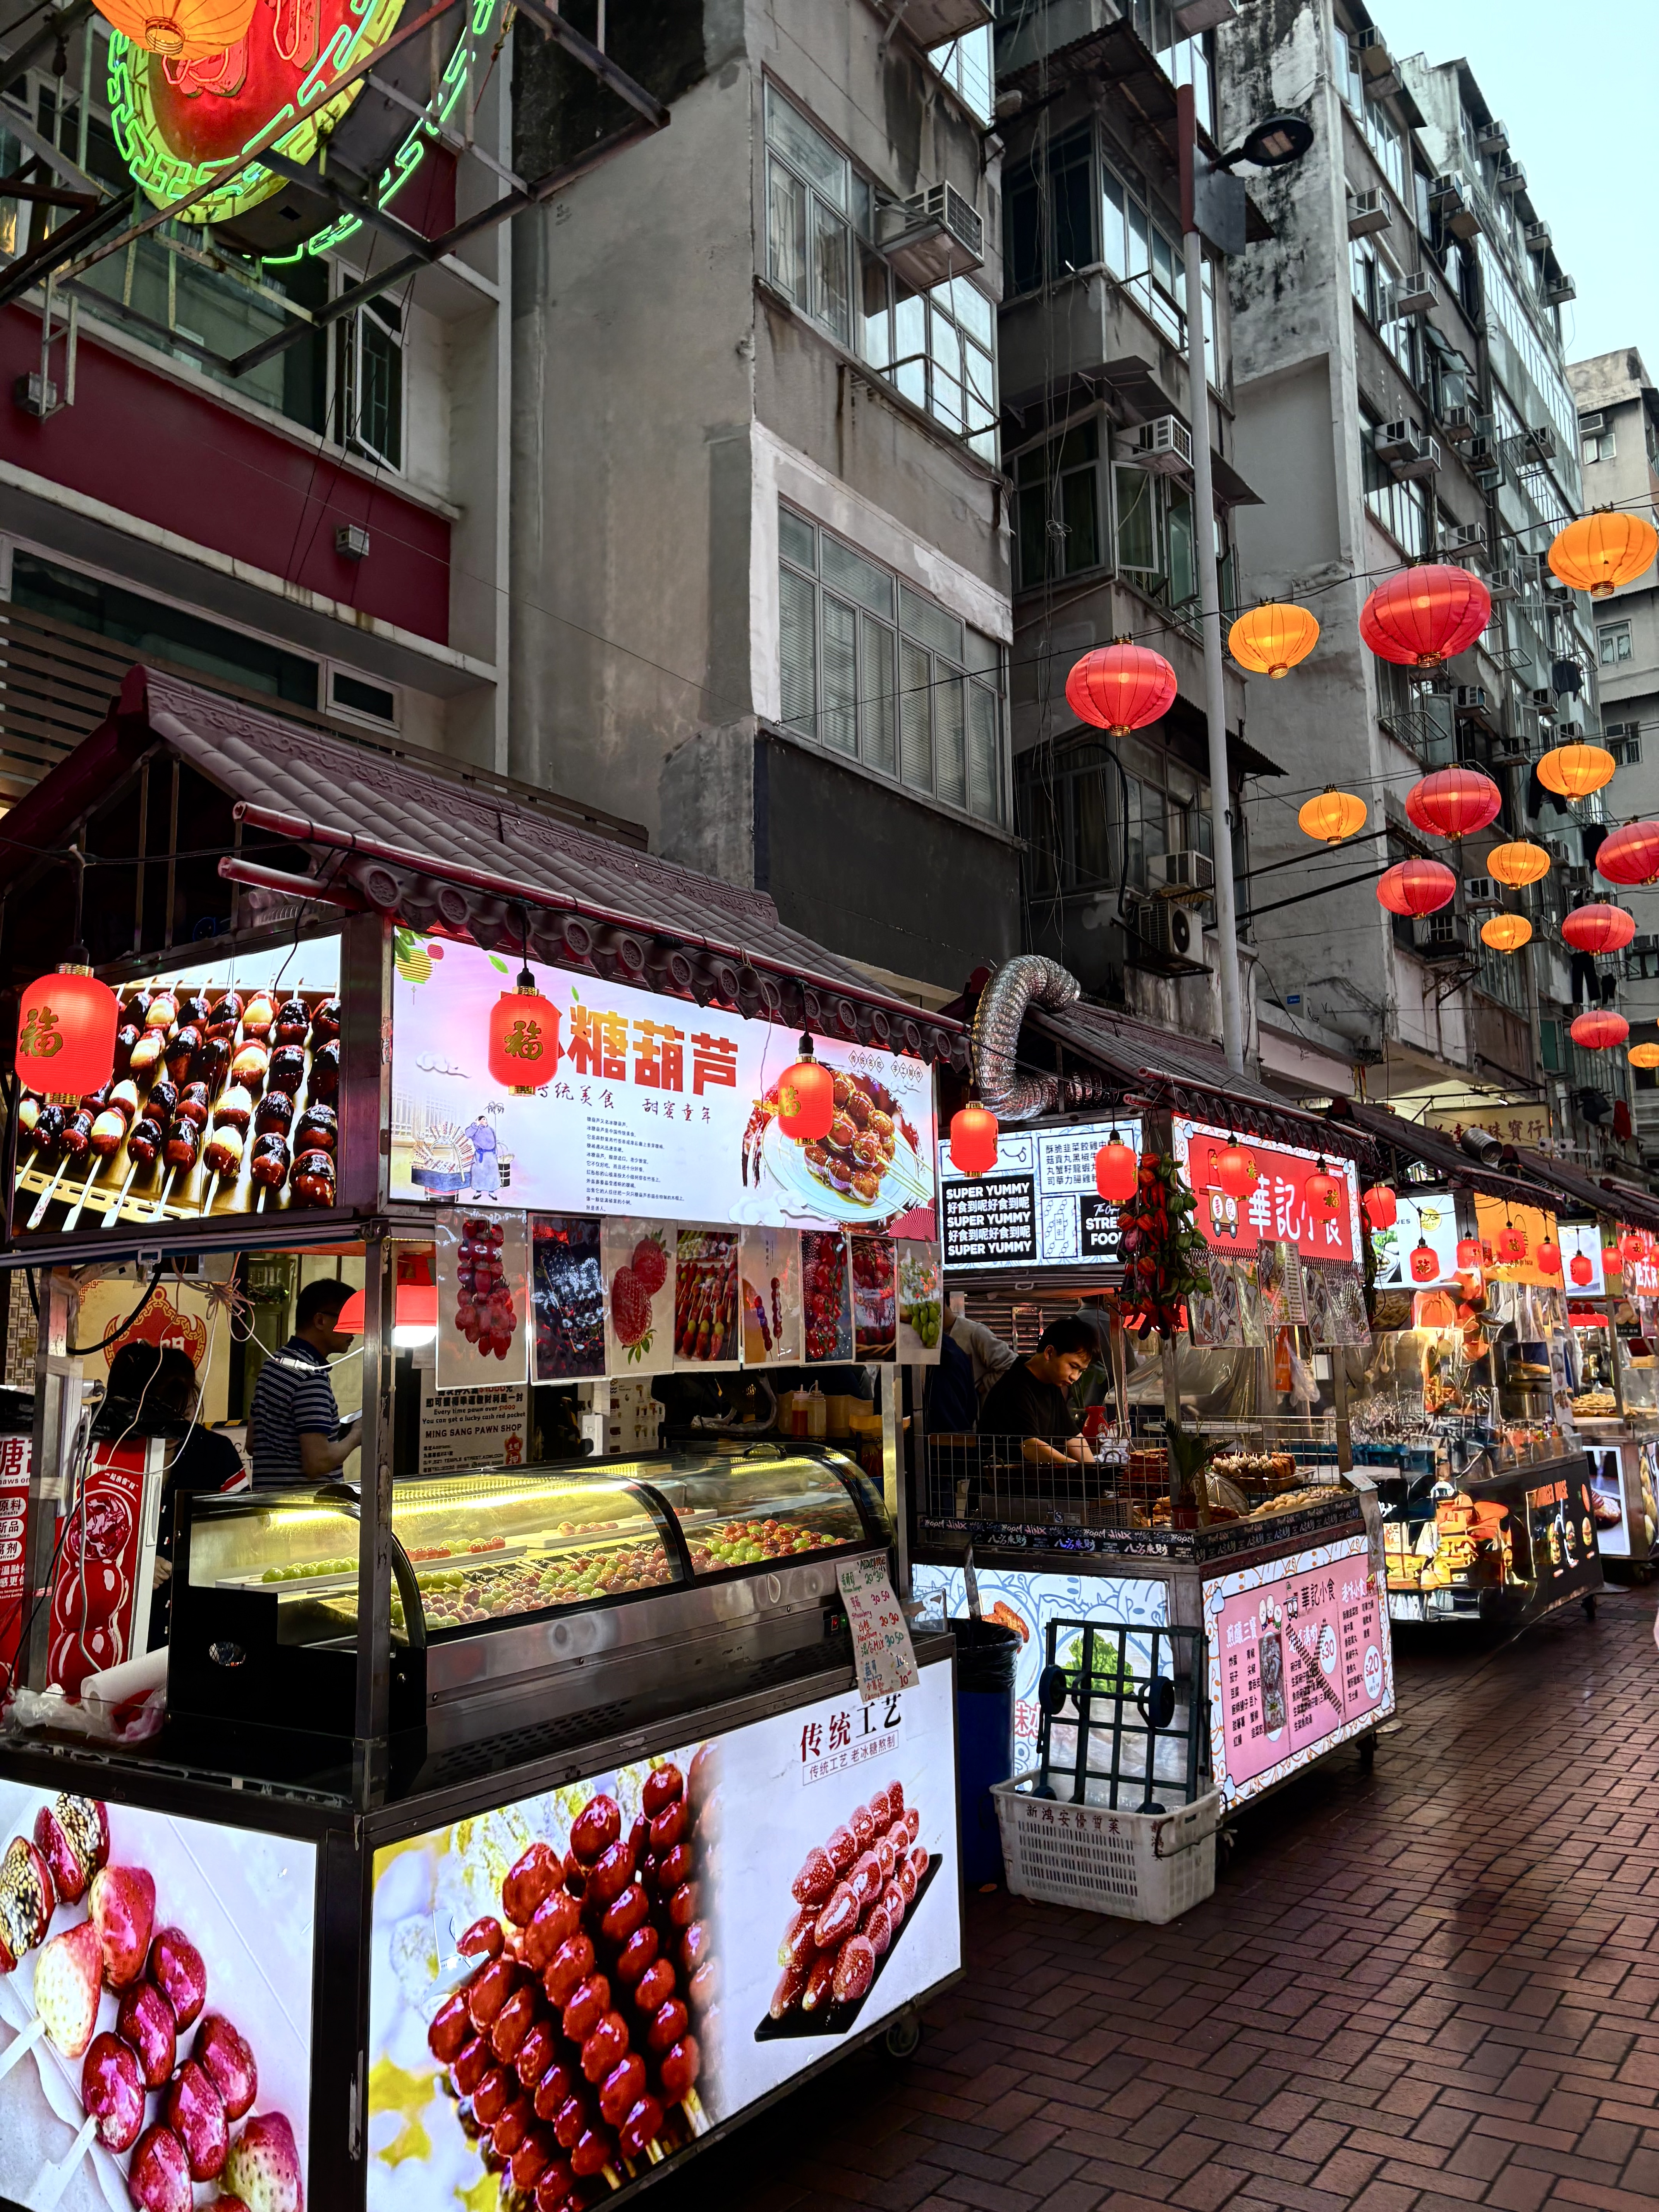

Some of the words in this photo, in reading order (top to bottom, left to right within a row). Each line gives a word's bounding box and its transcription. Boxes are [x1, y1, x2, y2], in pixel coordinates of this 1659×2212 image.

[20, 1006, 63, 1057] 福
[504, 1020, 543, 1060] 福
[558, 1005, 738, 1096] 糖葫芦
[642, 1098, 711, 1124] 甜蜜童年
[946, 1187, 983, 1199] SUPER
[986, 1182, 1030, 1196] YUMMY
[947, 1196, 1030, 1214] 好食到呢好食到呢
[947, 1215, 984, 1227] SUPER
[987, 1211, 1031, 1224] YUMMY
[1085, 1216, 1119, 1230] STRE
[948, 1225, 1030, 1242] 好食到呢好食到呢
[948, 1243, 986, 1256] SUPER
[988, 1240, 1032, 1254] YUMMY
[426, 1430, 447, 1438] MING
[450, 1427, 472, 1436] SANG
[475, 1425, 498, 1434] PAWN
[501, 1424, 522, 1432] SHOP
[875, 1570, 883, 1582] 30
[871, 1594, 880, 1605] 30
[881, 1590, 890, 1601] 50
[889, 1612, 899, 1625] 30
[895, 1632, 904, 1644] 50
[1366, 1653, 1379, 1677] $20
[899, 1675, 908, 1688] 10
[800, 1693, 901, 1762] 传统工艺
[810, 1753, 847, 1780] 传统工艺
[851, 1734, 895, 1762] 老冰糖熬制
